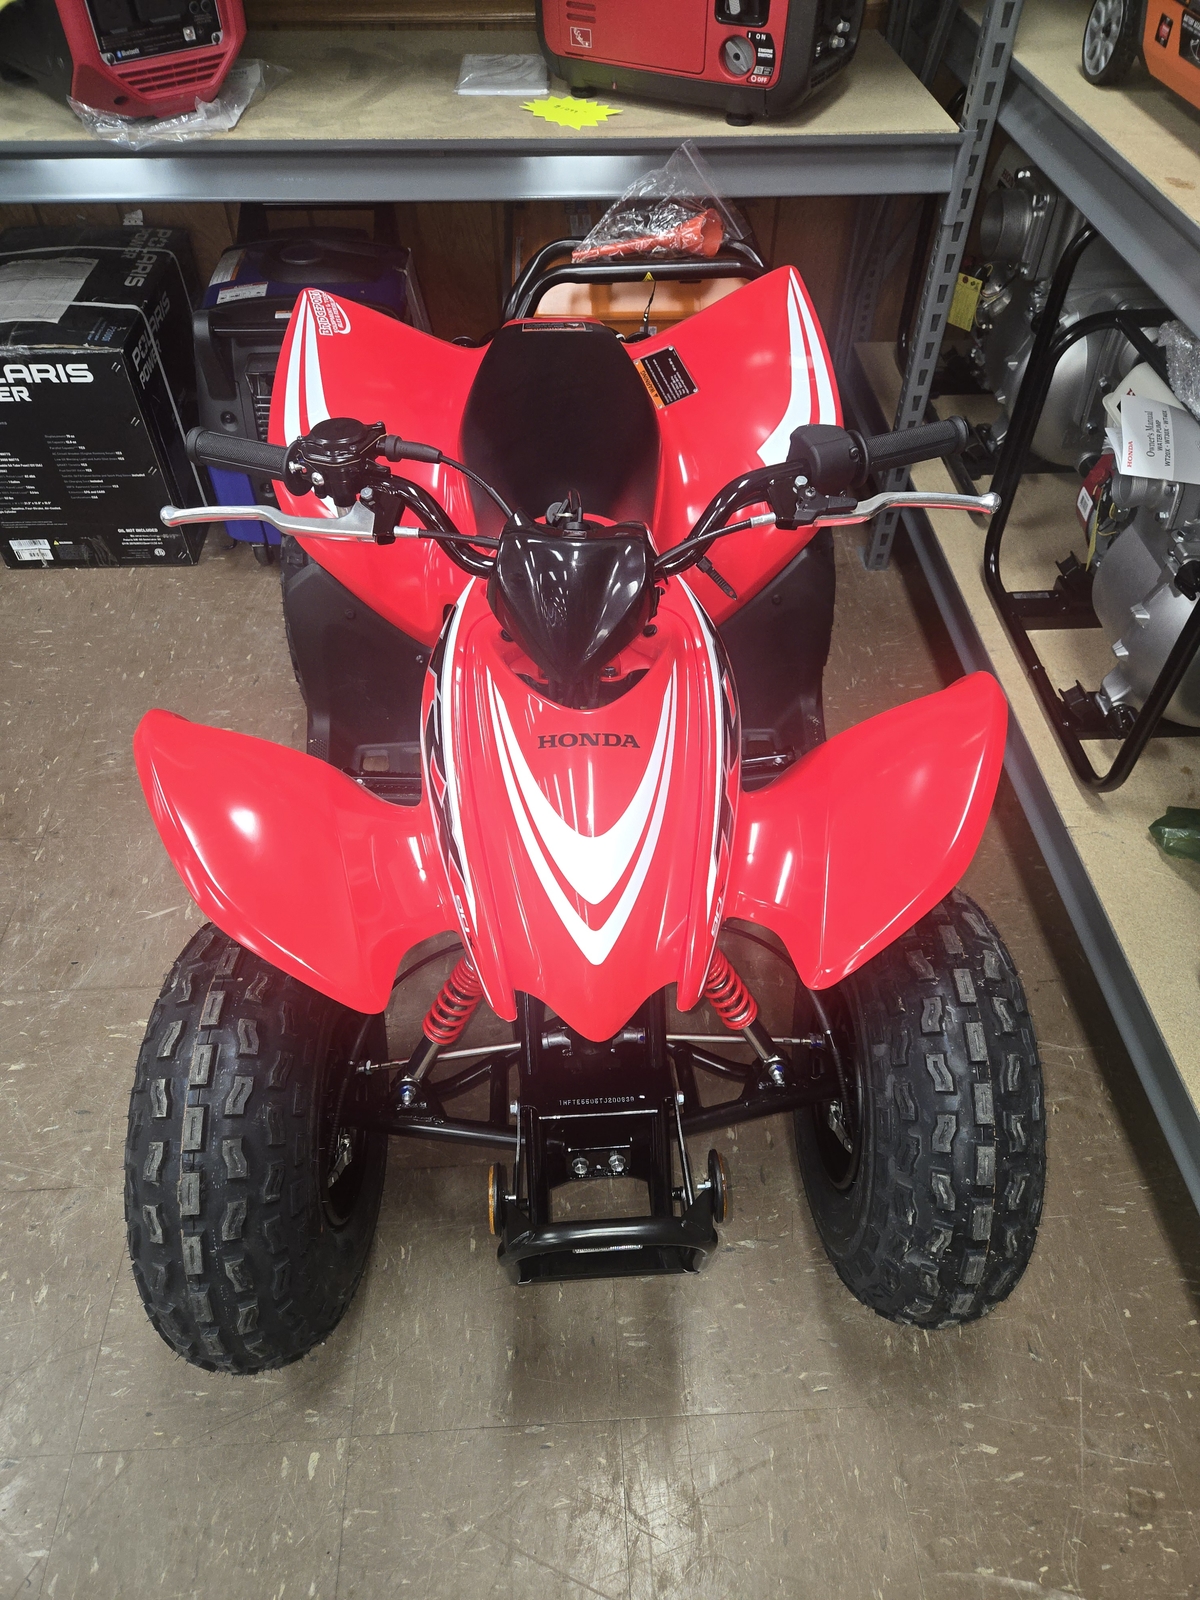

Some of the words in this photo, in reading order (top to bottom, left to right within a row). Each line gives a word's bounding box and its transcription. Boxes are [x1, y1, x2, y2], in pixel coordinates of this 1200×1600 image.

[755, 33, 766, 41] ON
[310, 290, 332, 334] BRIDGEPORT
[1144, 410, 1154, 431] Manual
[1146, 432, 1155, 457] Owner's
[537, 733, 641, 749] HONDA
